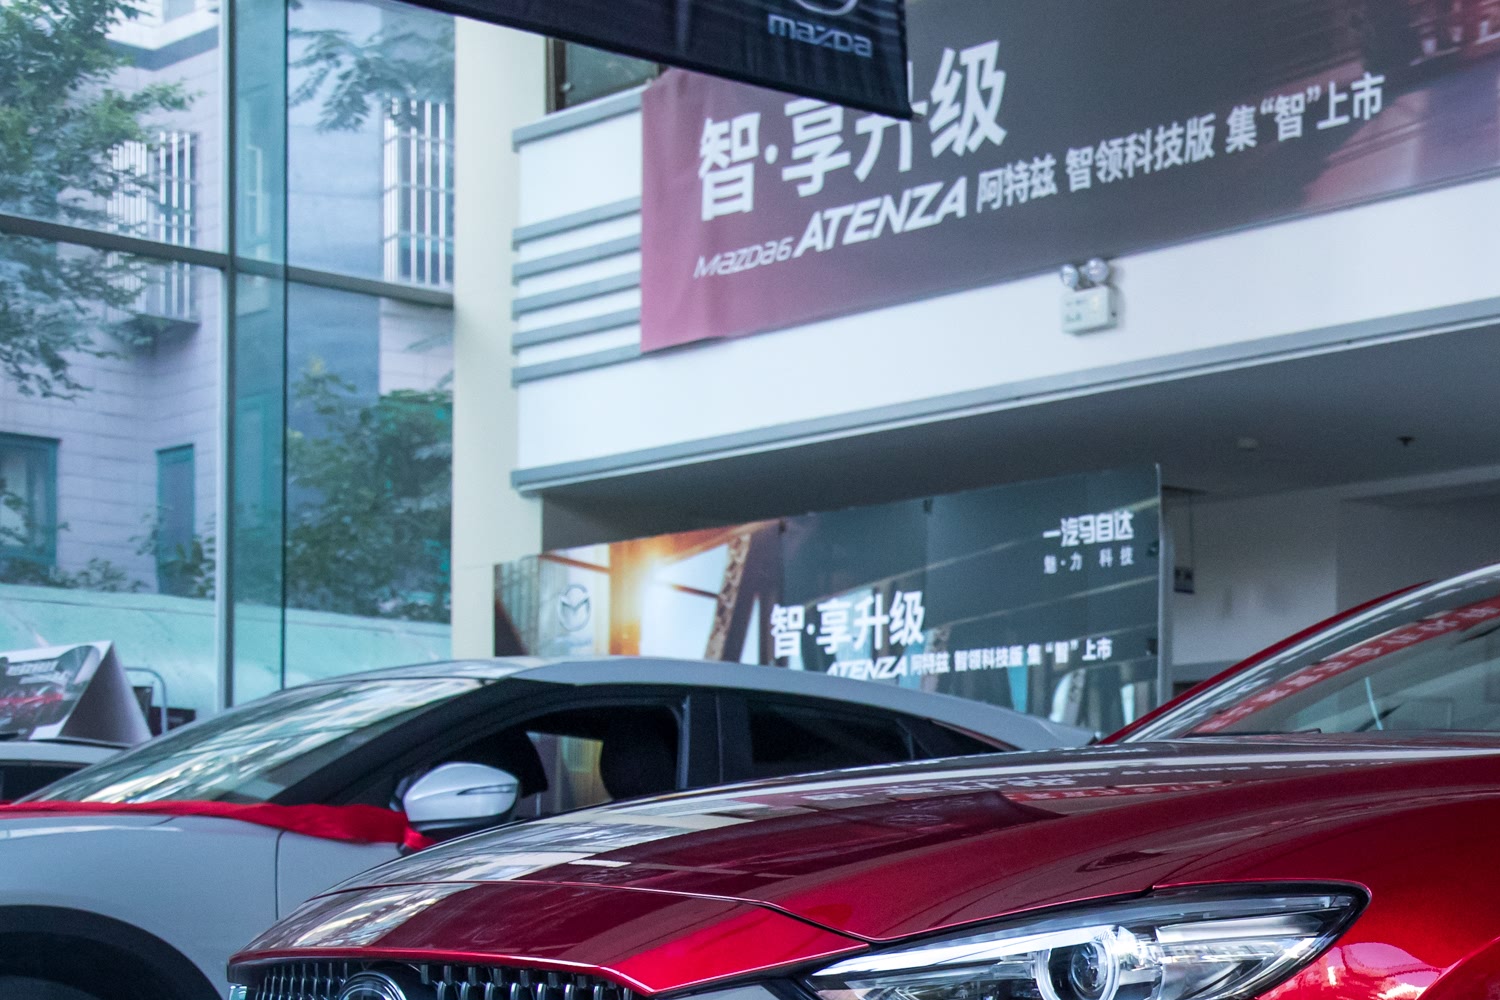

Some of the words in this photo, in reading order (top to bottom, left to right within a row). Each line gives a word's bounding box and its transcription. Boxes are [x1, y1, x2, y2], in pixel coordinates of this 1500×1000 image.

[793, 176, 969, 259] ATENZA
[976, 153, 1059, 214] 阿特兹
[1065, 113, 1218, 193] 智领科技版
[1042, 510, 1135, 547] 一汽马自达
